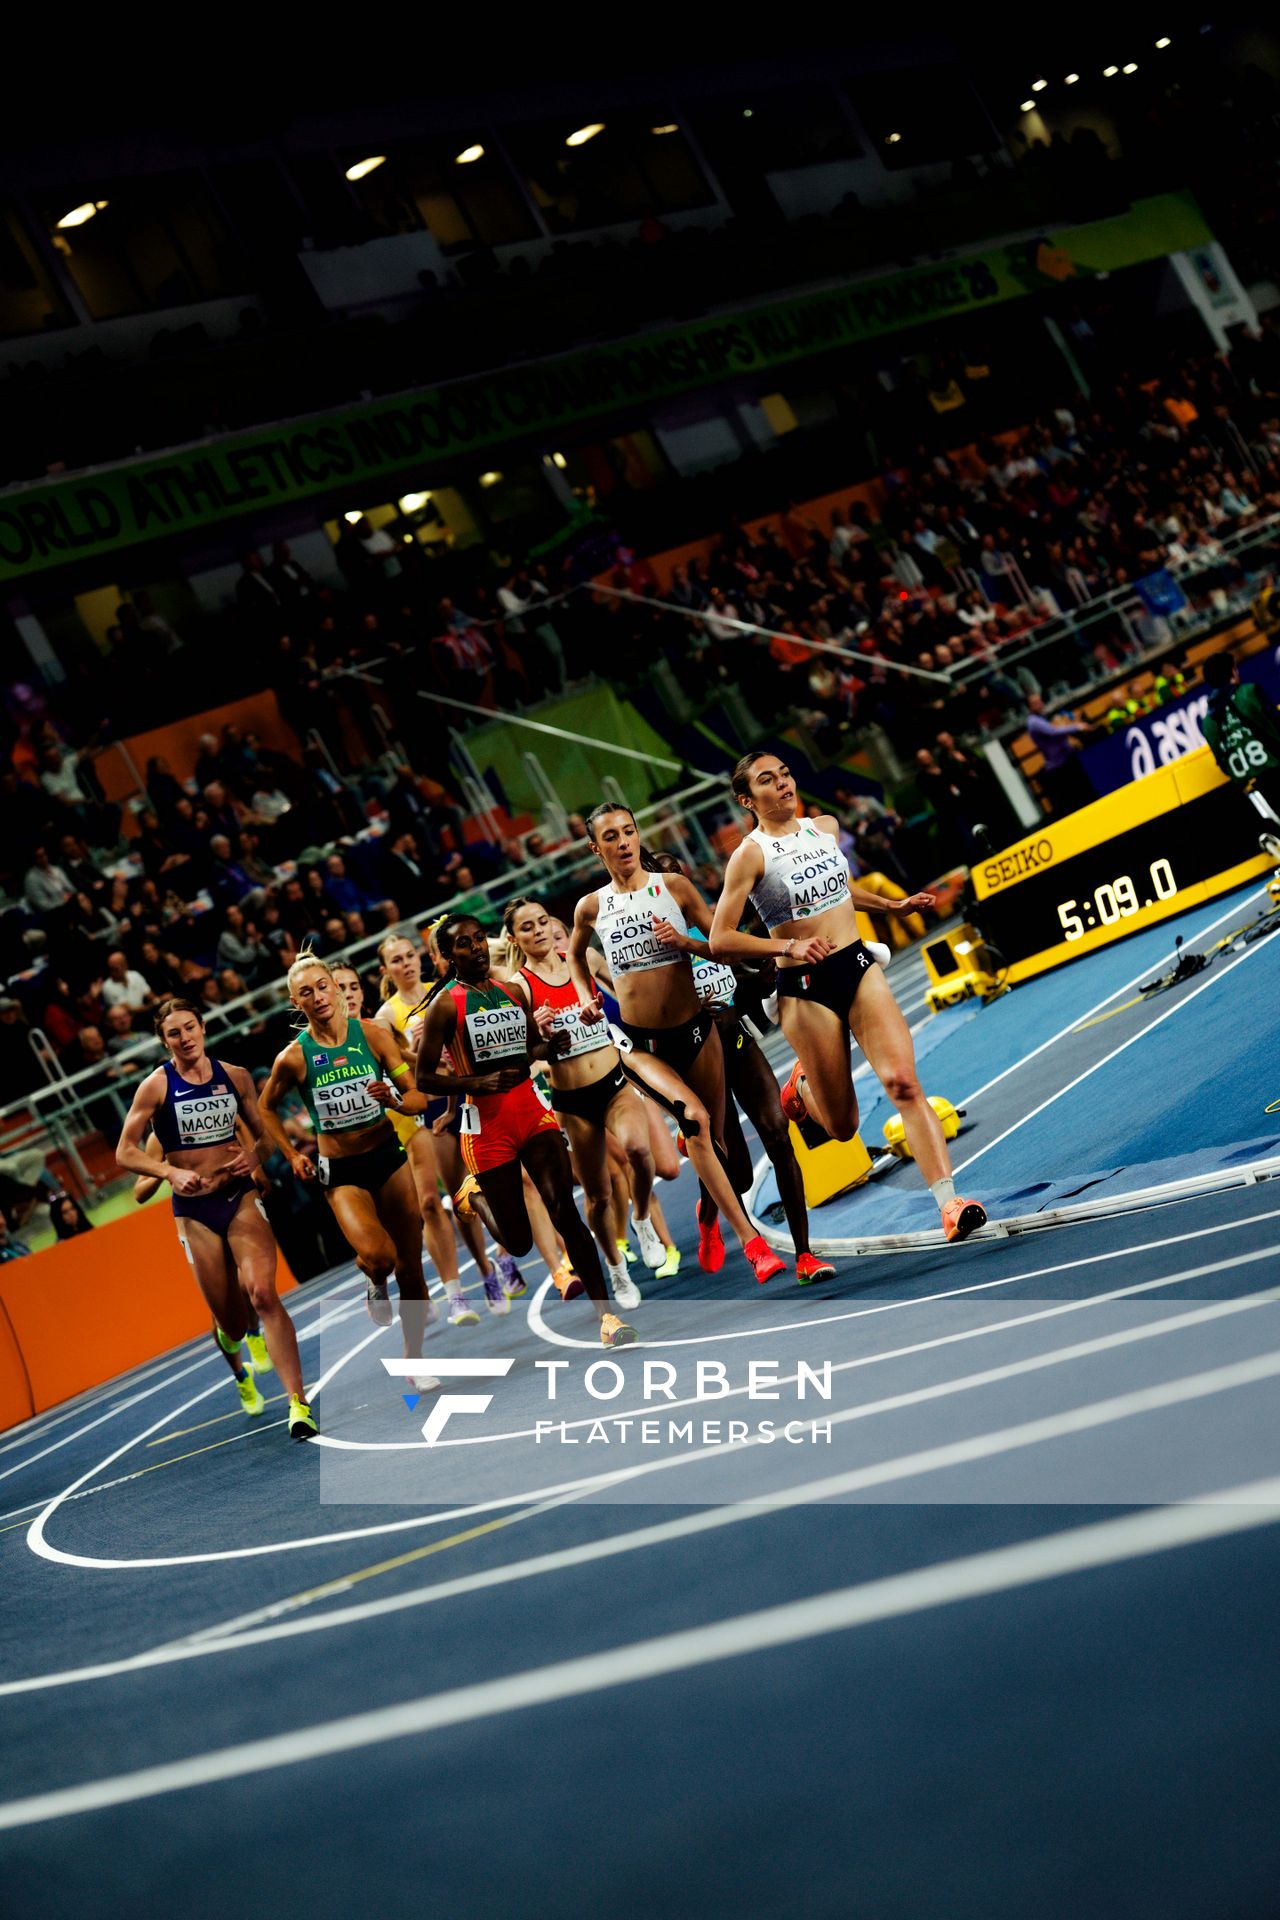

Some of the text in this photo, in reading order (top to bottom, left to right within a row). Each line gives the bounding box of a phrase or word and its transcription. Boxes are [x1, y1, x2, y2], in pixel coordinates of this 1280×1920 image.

[126, 425, 355, 530] ATHLETICS
[346, 387, 503, 469] INDOOR
[498, 322, 758, 428] CHAMPIONSHIPS
[792, 847, 828, 865] ITALIA
[984, 839, 1053, 888] SEIKO
[791, 856, 840, 886] SONY
[795, 870, 848, 906] MAJORI
[610, 916, 667, 944] SON
[616, 910, 653, 927] ITALIA
[695, 974, 735, 999] ERUTO
[473, 1010, 521, 1028] SONY
[475, 1025, 527, 1049] BAWEKE
[316, 1064, 375, 1088] AUSTRALIA
[318, 1078, 371, 1101] SONY
[182, 1098, 230, 1115] SONY
[327, 1096, 372, 1116] HULL
[181, 1111, 235, 1133] MACKAY
